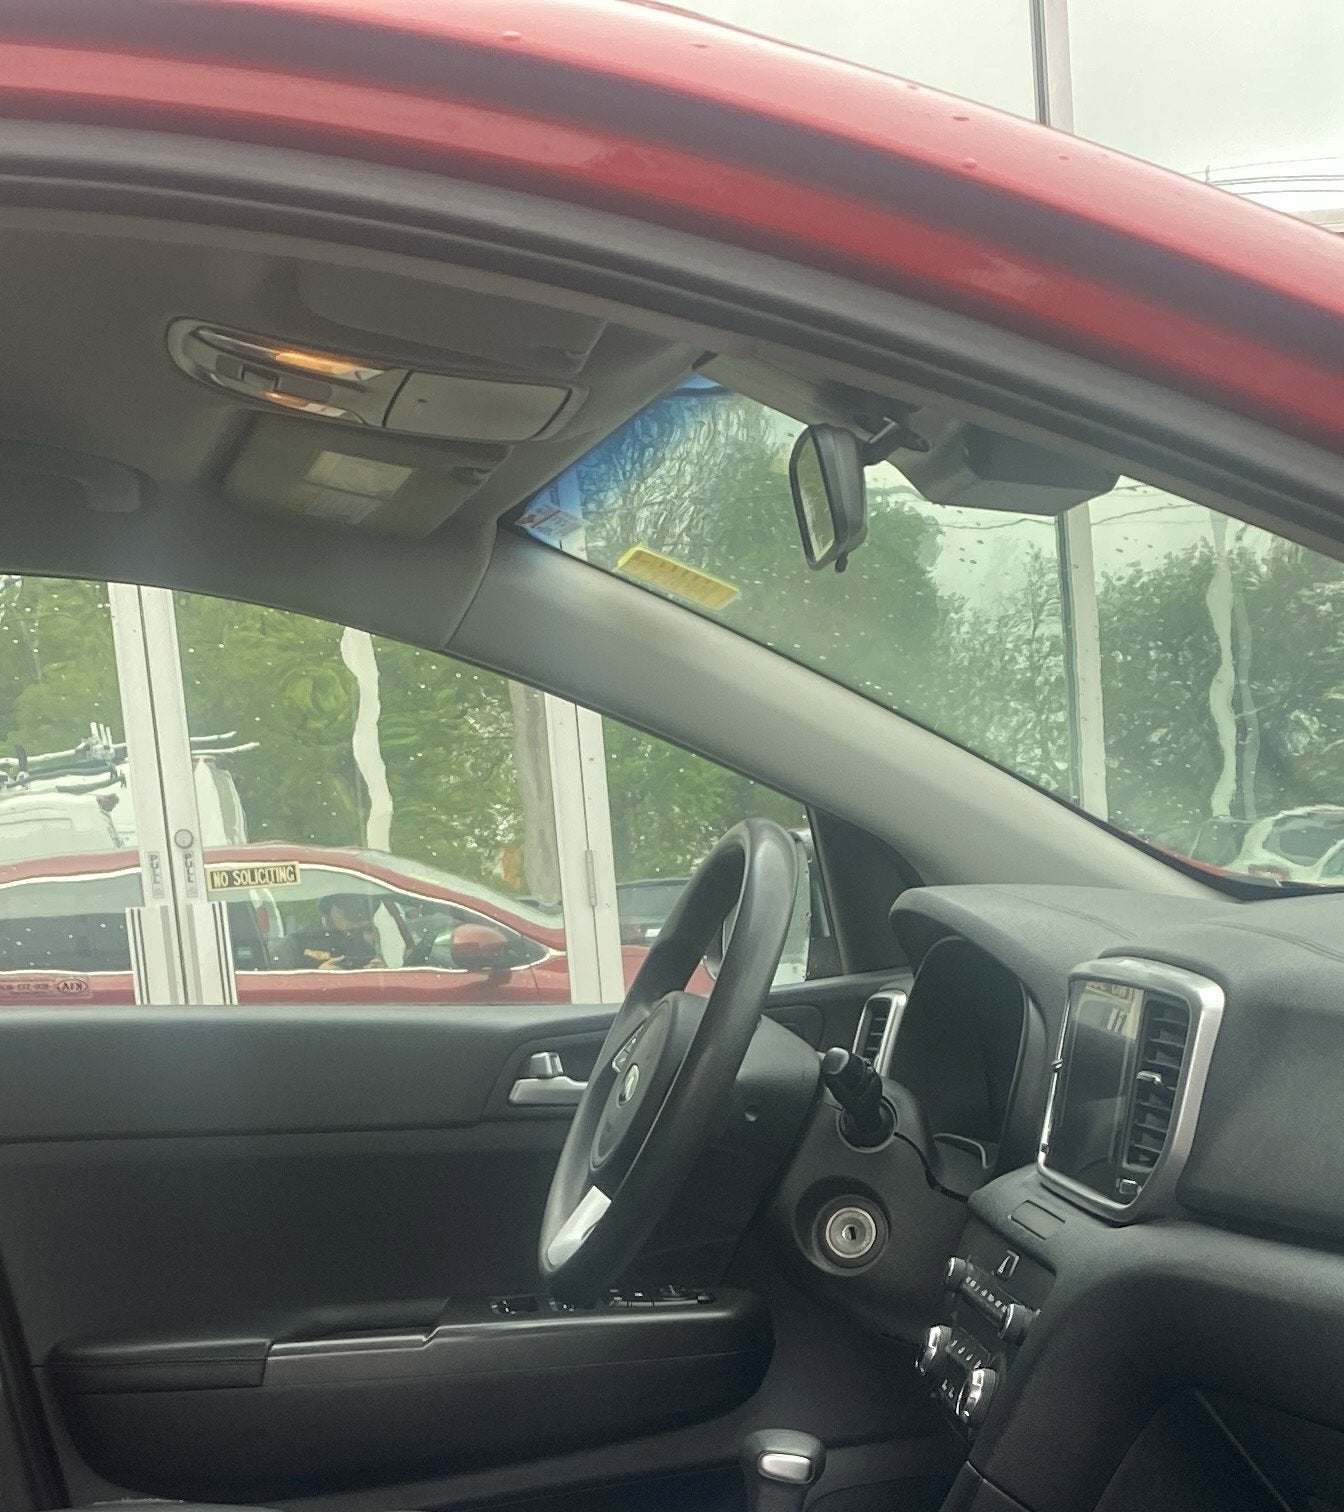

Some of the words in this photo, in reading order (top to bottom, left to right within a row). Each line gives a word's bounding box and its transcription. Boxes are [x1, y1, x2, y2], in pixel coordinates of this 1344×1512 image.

[150, 854, 161, 884] PULL
[184, 853, 194, 883] PULL
[213, 871, 229, 887] NO
[234, 866, 295, 886] SOLICITING
